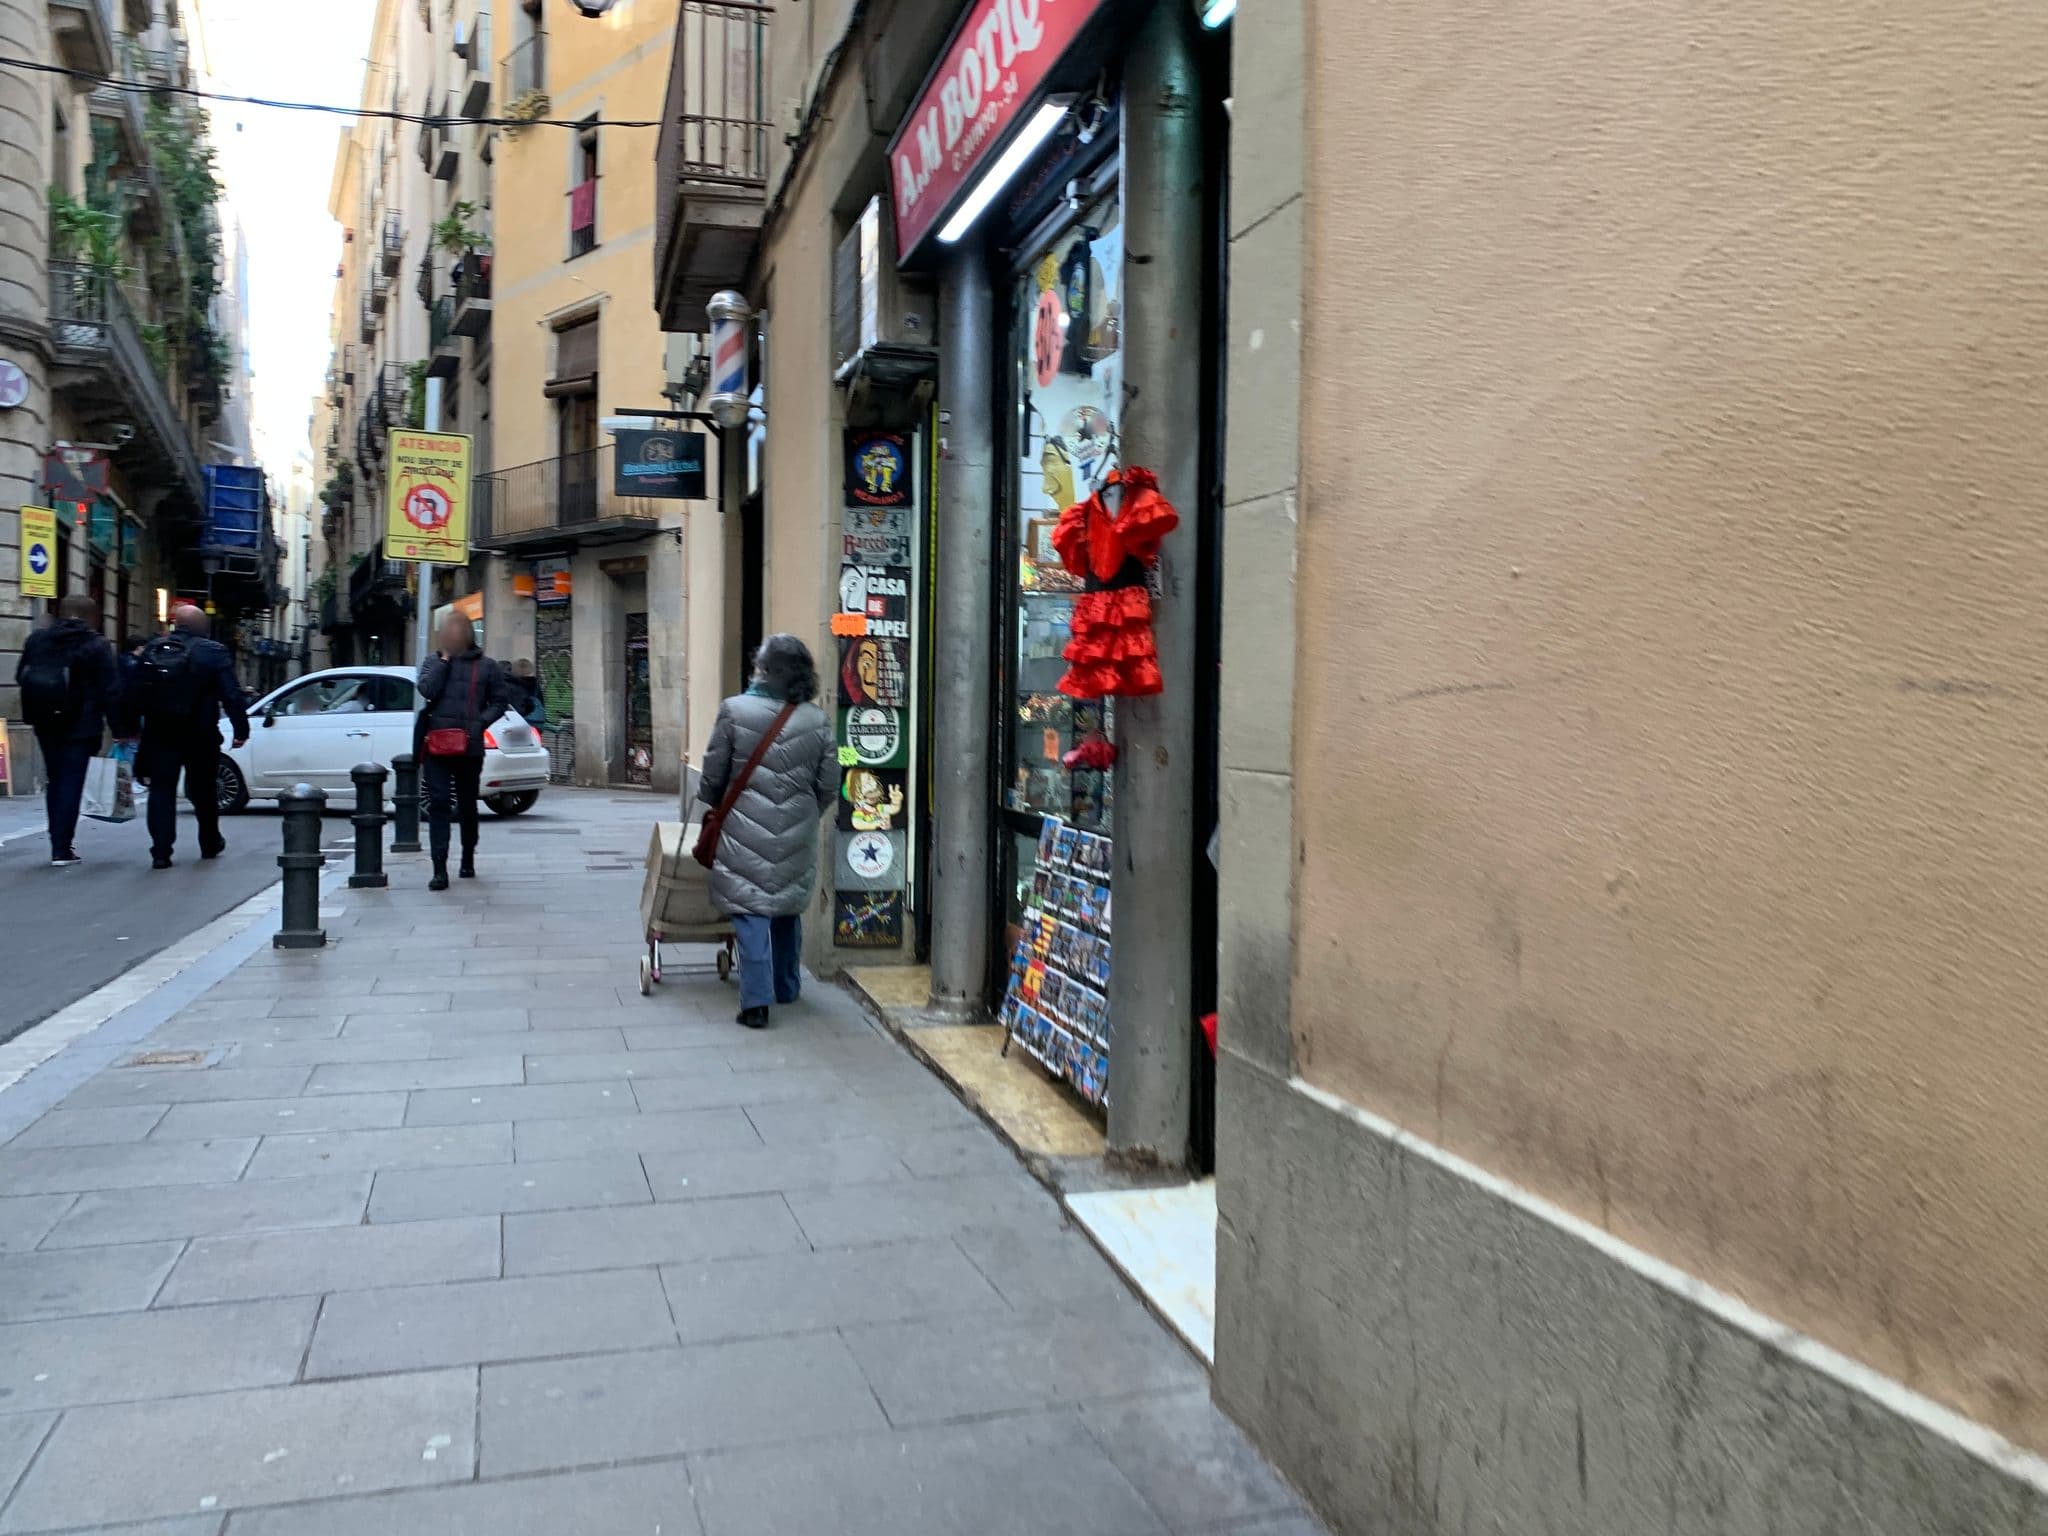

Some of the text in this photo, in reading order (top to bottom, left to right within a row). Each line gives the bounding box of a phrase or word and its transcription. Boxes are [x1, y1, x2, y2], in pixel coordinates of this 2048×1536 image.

[940, 0, 1057, 150] BOTIQ
[867, 577, 907, 596] CASA
[868, 599, 884, 613] DE
[866, 619, 909, 638] PAPEL
